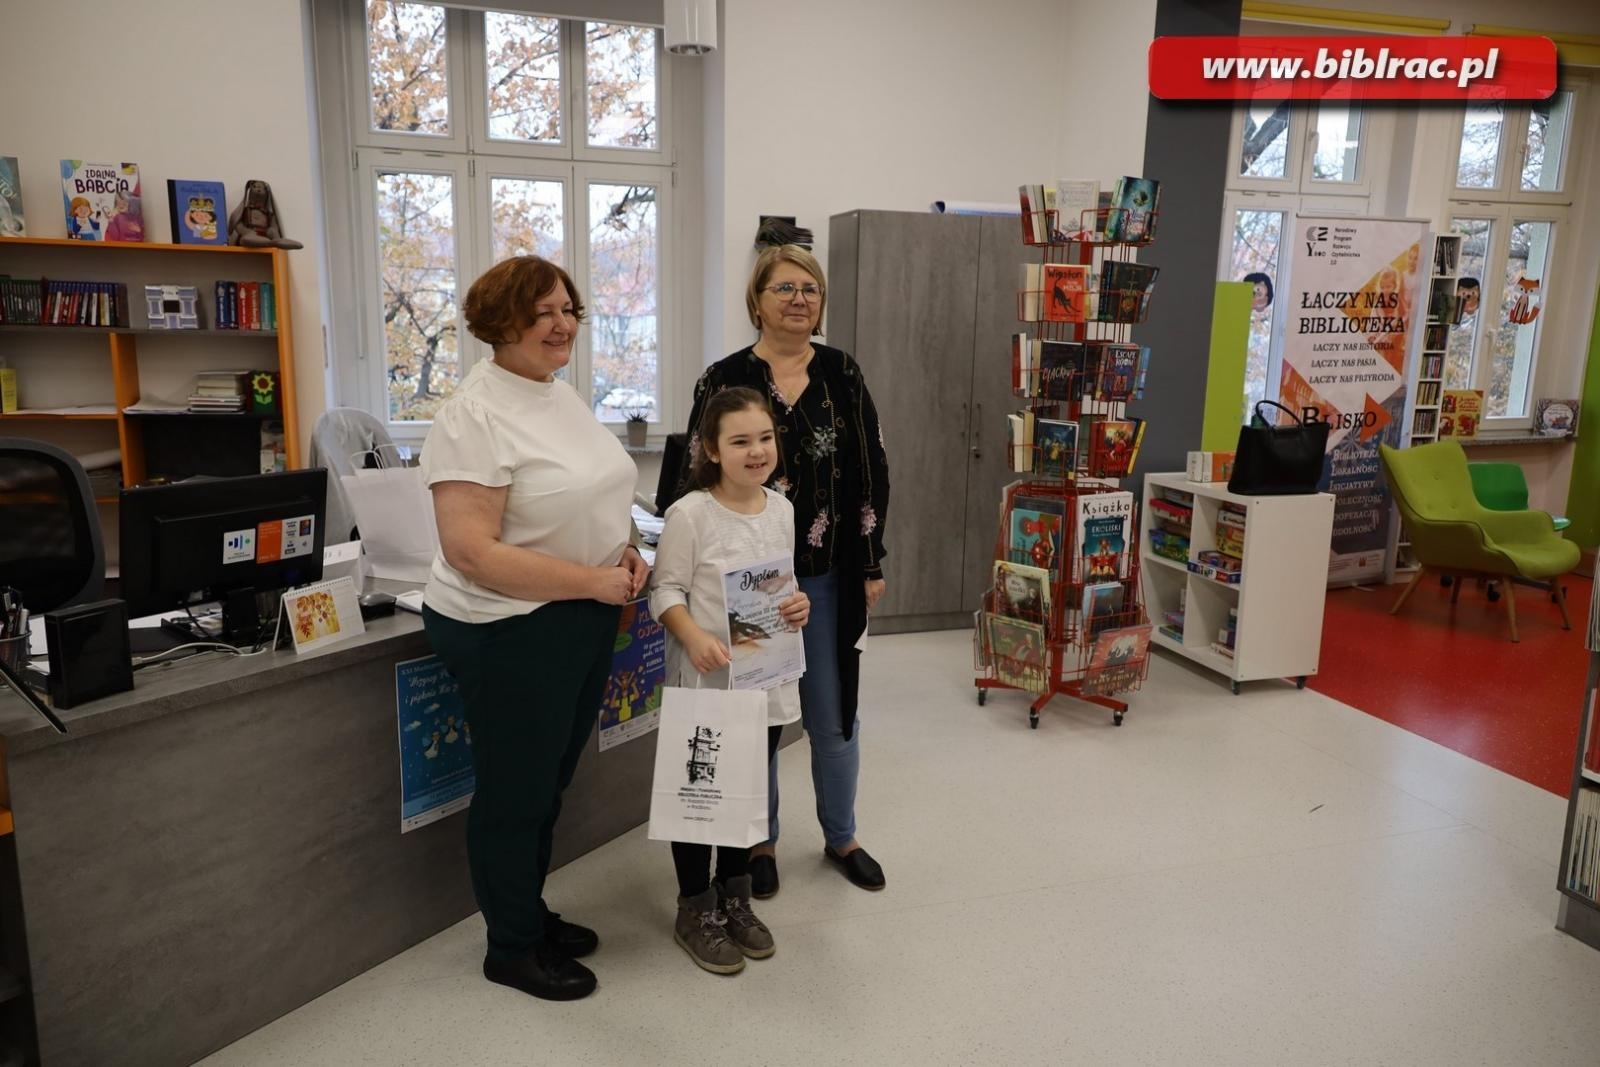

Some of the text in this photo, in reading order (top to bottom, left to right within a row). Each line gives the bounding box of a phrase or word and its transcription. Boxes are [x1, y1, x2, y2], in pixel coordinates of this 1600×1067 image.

[85, 169, 116, 179] ZDALNA
[1301, 291, 1399, 311] ŁĄCZY NAS
[1298, 316, 1405, 334] BIBLIOTEKA
[1313, 342, 1395, 352] ŁĄCZY NAS HISTORIA
[1115, 350, 1137, 359] ESCAPE
[1311, 358, 1377, 368] ŁĄCZY NAS PASJA
[1309, 374, 1395, 384] ŁĄCZY NAS PRZYRODA
[1082, 499, 1130, 515] Książka
[740, 568, 780, 591] Dyplom
